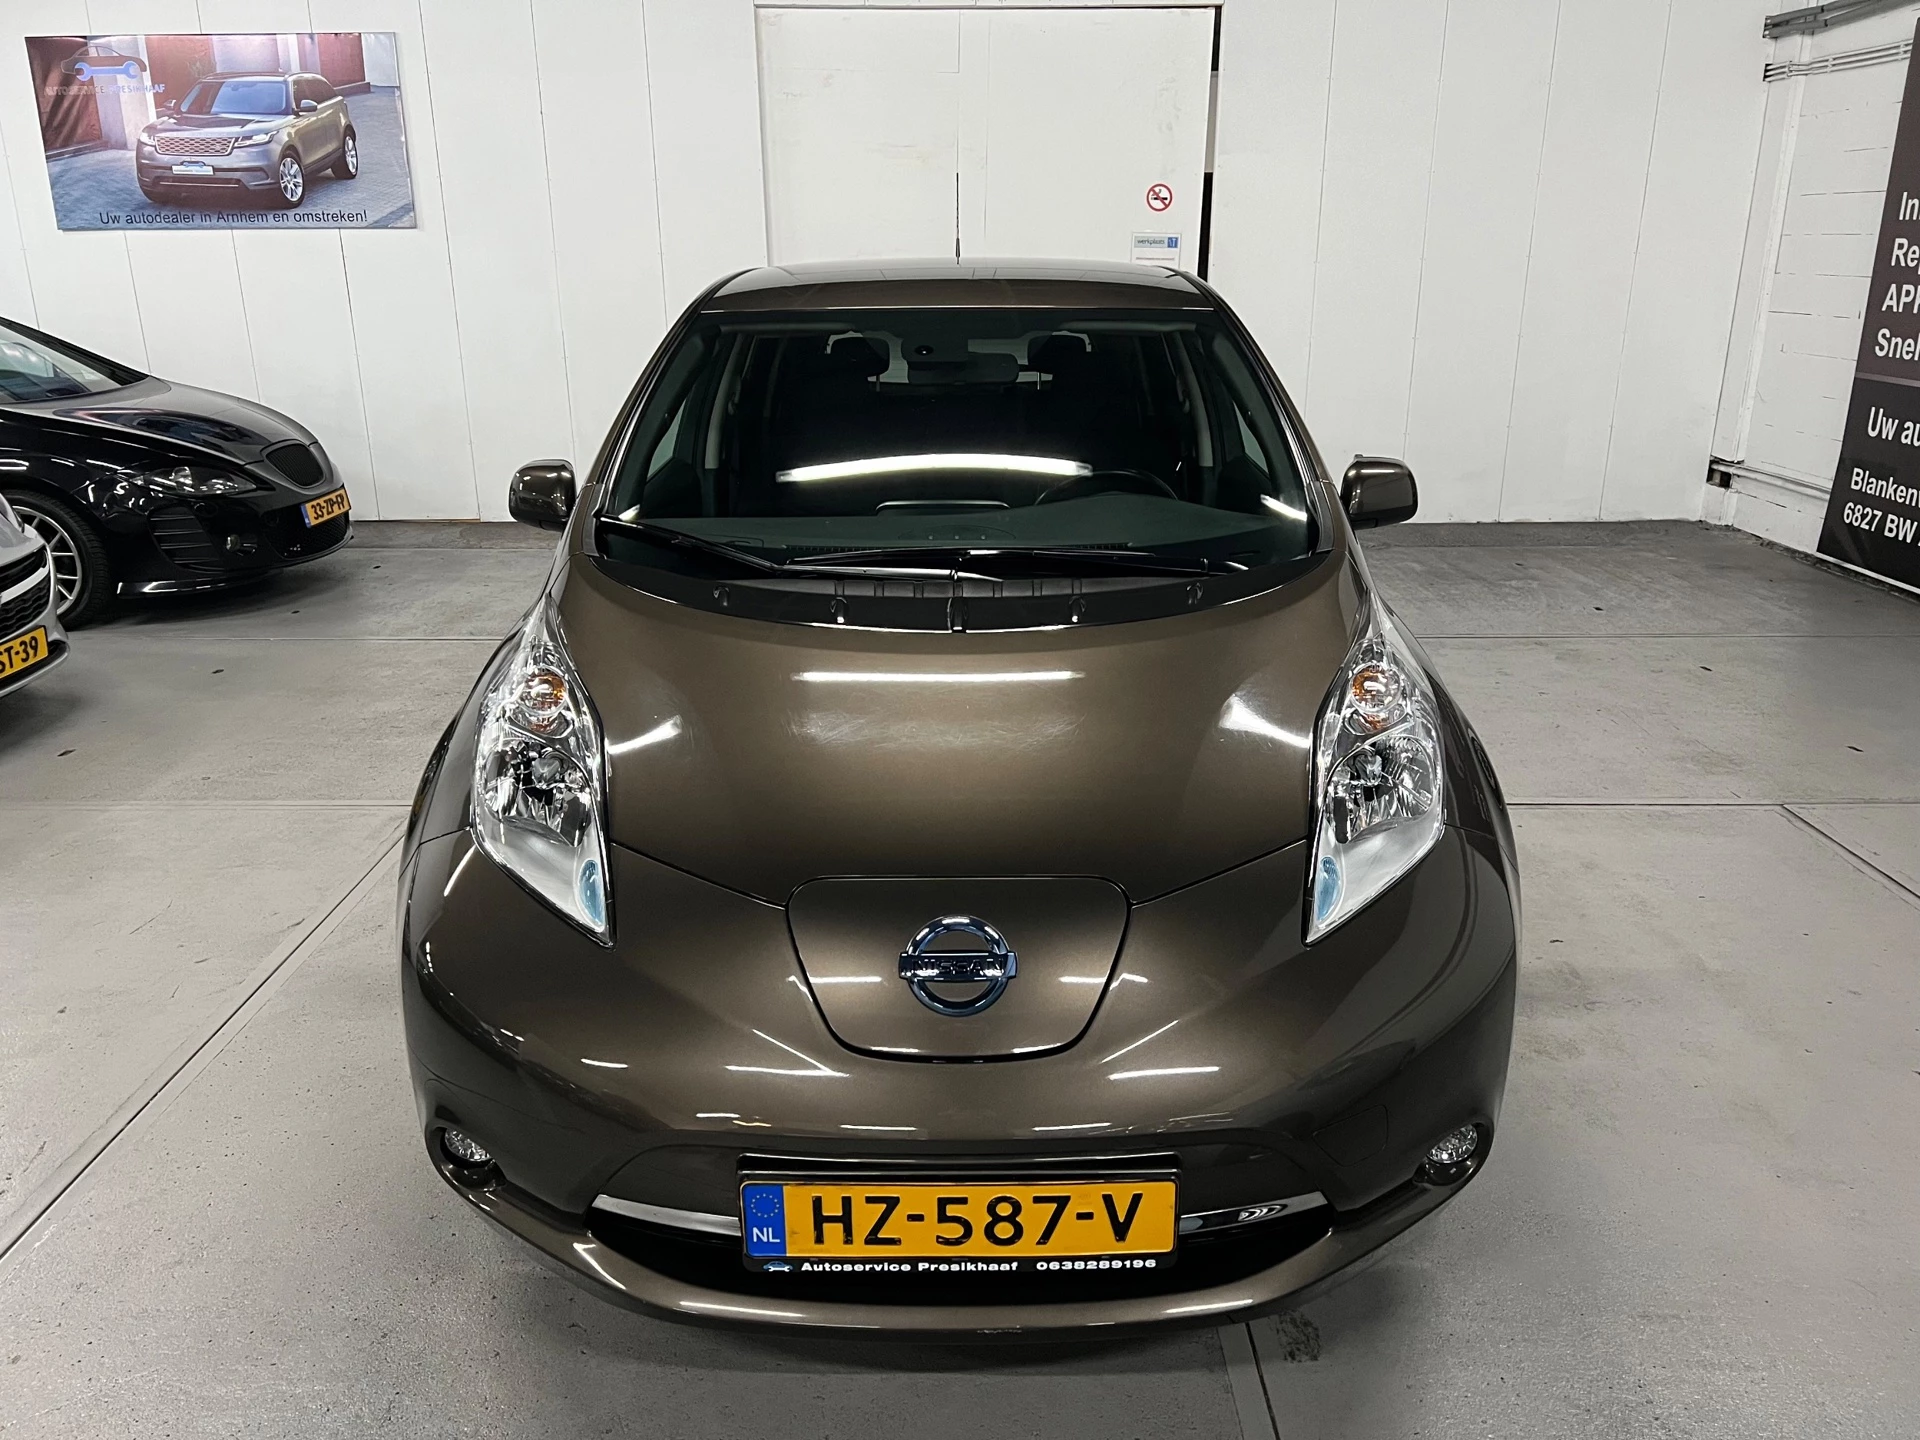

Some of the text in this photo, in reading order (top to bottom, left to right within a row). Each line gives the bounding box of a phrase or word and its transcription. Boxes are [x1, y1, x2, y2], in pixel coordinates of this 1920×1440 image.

[99, 210, 368, 225] Uw autodealer in Arnhem en omstreken!
[1899, 191, 1920, 221] In
[1891, 237, 1920, 275] Re
[1867, 406, 1899, 441] Uw
[1850, 467, 1920, 508] Blanken
[1843, 501, 1918, 544] 6827 BW
[752, 1227, 780, 1242] NL
[812, 1193, 1144, 1246] HZ-587-V
[801, 1259, 1157, 1272] Autoservice Presikhaaf 0638289196
